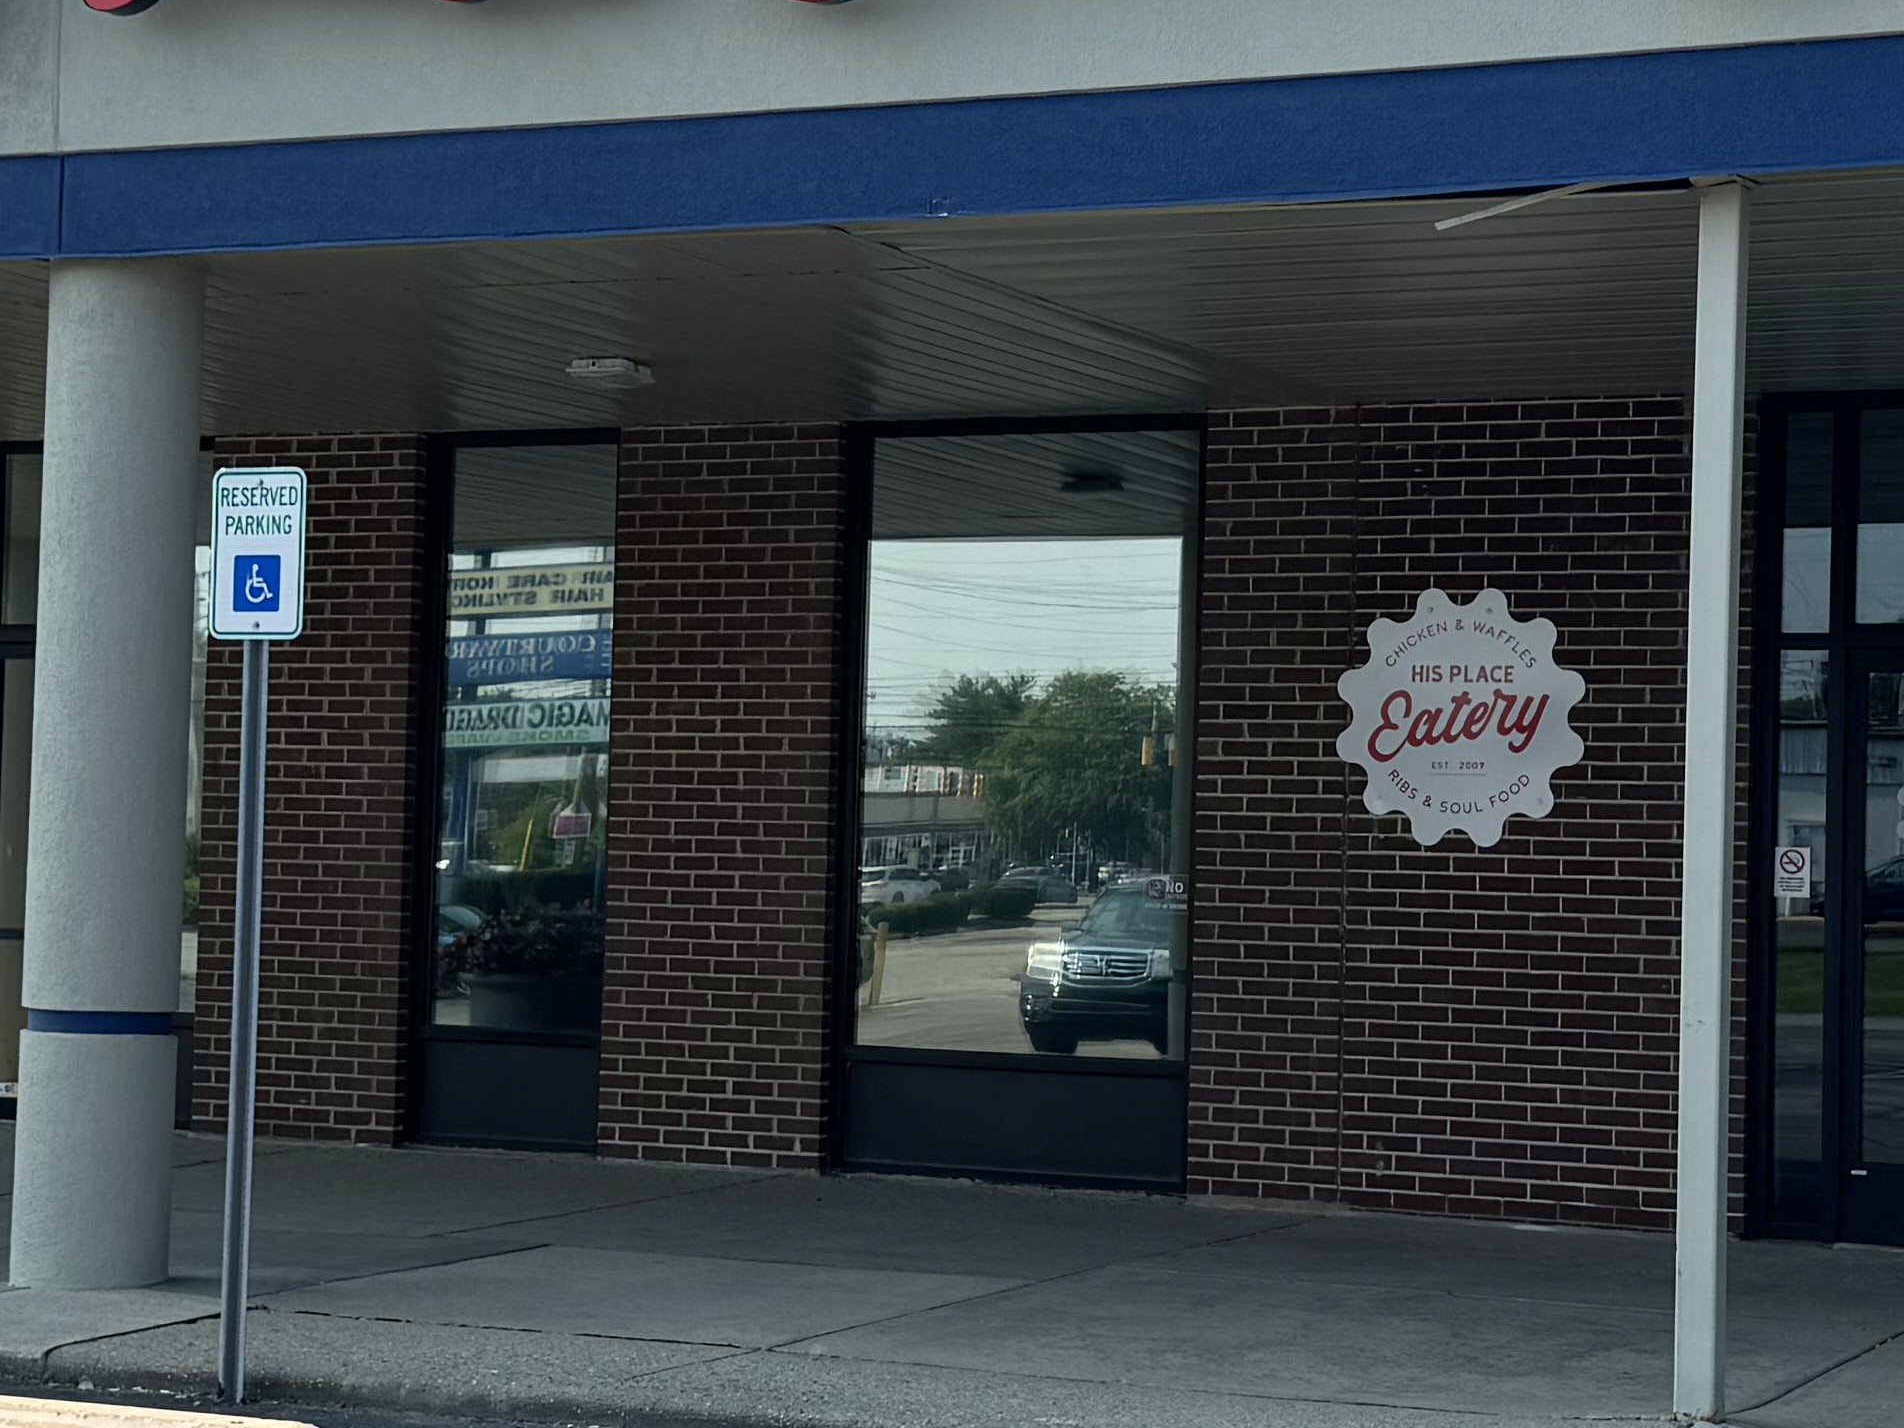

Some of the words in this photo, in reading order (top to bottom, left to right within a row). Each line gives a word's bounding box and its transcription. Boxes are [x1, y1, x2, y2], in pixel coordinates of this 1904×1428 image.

[221, 486, 298, 507] RESERVED
[225, 515, 292, 535] PARKING
[1385, 621, 1448, 667] CHICKEN
[1454, 619, 1465, 631] &
[1473, 620, 1538, 668] WAFFLES
[1411, 664, 1443, 683] HIS
[1449, 664, 1514, 683] PLACE
[1367, 688, 1550, 762] Eatery
[1388, 769, 1418, 800] RIBS
[1422, 795, 1433, 807] &
[1439, 800, 1484, 814] SOUL
[1489, 774, 1530, 808] FOOD
[1166, 881, 1184, 893] NO
